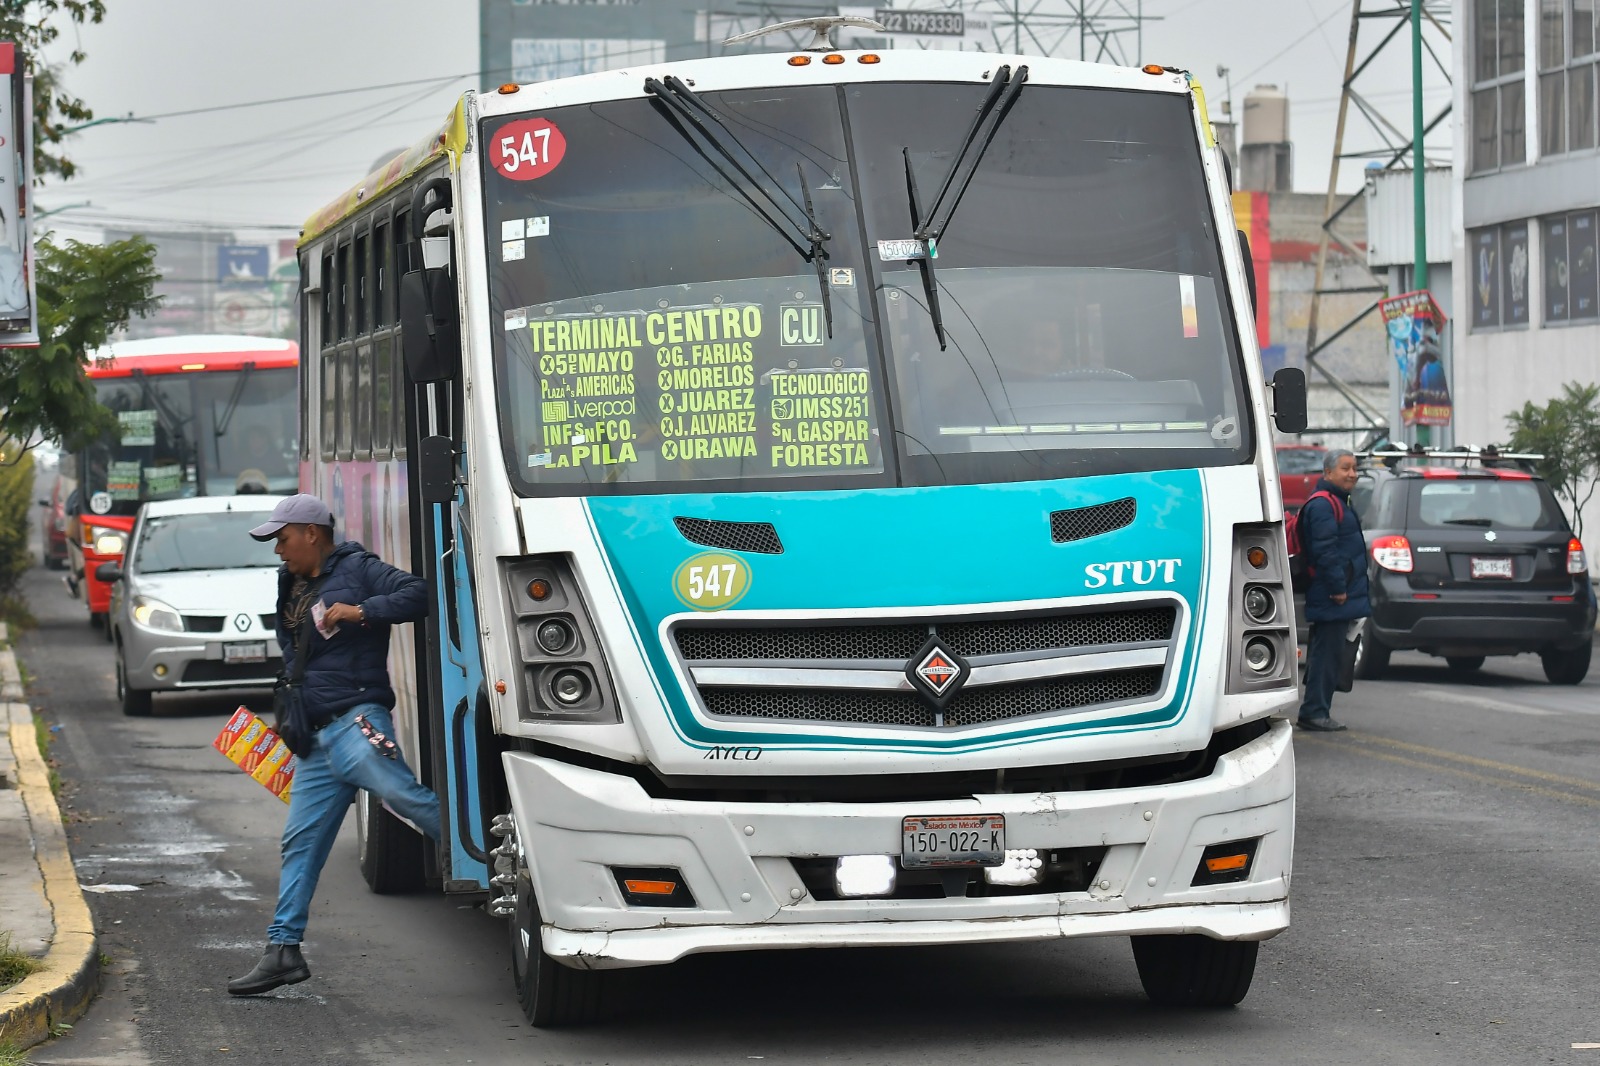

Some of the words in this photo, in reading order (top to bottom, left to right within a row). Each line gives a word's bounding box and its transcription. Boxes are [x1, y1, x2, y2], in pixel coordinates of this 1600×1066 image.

[906, 13, 962, 33] 1993330
[501, 128, 551, 172] 547
[529, 317, 642, 352] TERMINAL
[646, 305, 762, 345] CENTRO
[783, 308, 821, 344] C.U.
[556, 355, 567, 375] 5
[578, 350, 633, 373] MAYO
[672, 346, 689, 366] G.
[691, 341, 754, 365] FARIAS
[541, 379, 565, 399] PLAZA
[576, 374, 635, 397] AMERICAS
[674, 365, 754, 390] MORELOS
[771, 373, 868, 395] TECNOLOGICO
[566, 397, 636, 419] Liverpool
[677, 388, 755, 413] JUAREZ
[796, 397, 842, 418] IMSS
[844, 396, 869, 418] 251
[543, 424, 572, 446] INF
[596, 419, 636, 442] FCO.
[675, 416, 688, 436] J.
[691, 412, 757, 435] ALVAREZ
[798, 420, 869, 442] GASPAR
[545, 448, 570, 469] LA
[572, 442, 638, 467] PILA
[680, 436, 757, 460] URAWA
[772, 443, 869, 467] FORESTA
[689, 563, 736, 600] 547
[1084, 559, 1182, 588] STUT
[703, 746, 763, 760] AYCO
[924, 821, 947, 830] Estado
[949, 821, 957, 829] de
[958, 821, 984, 829] México
[909, 830, 1000, 852] 150-022-K
